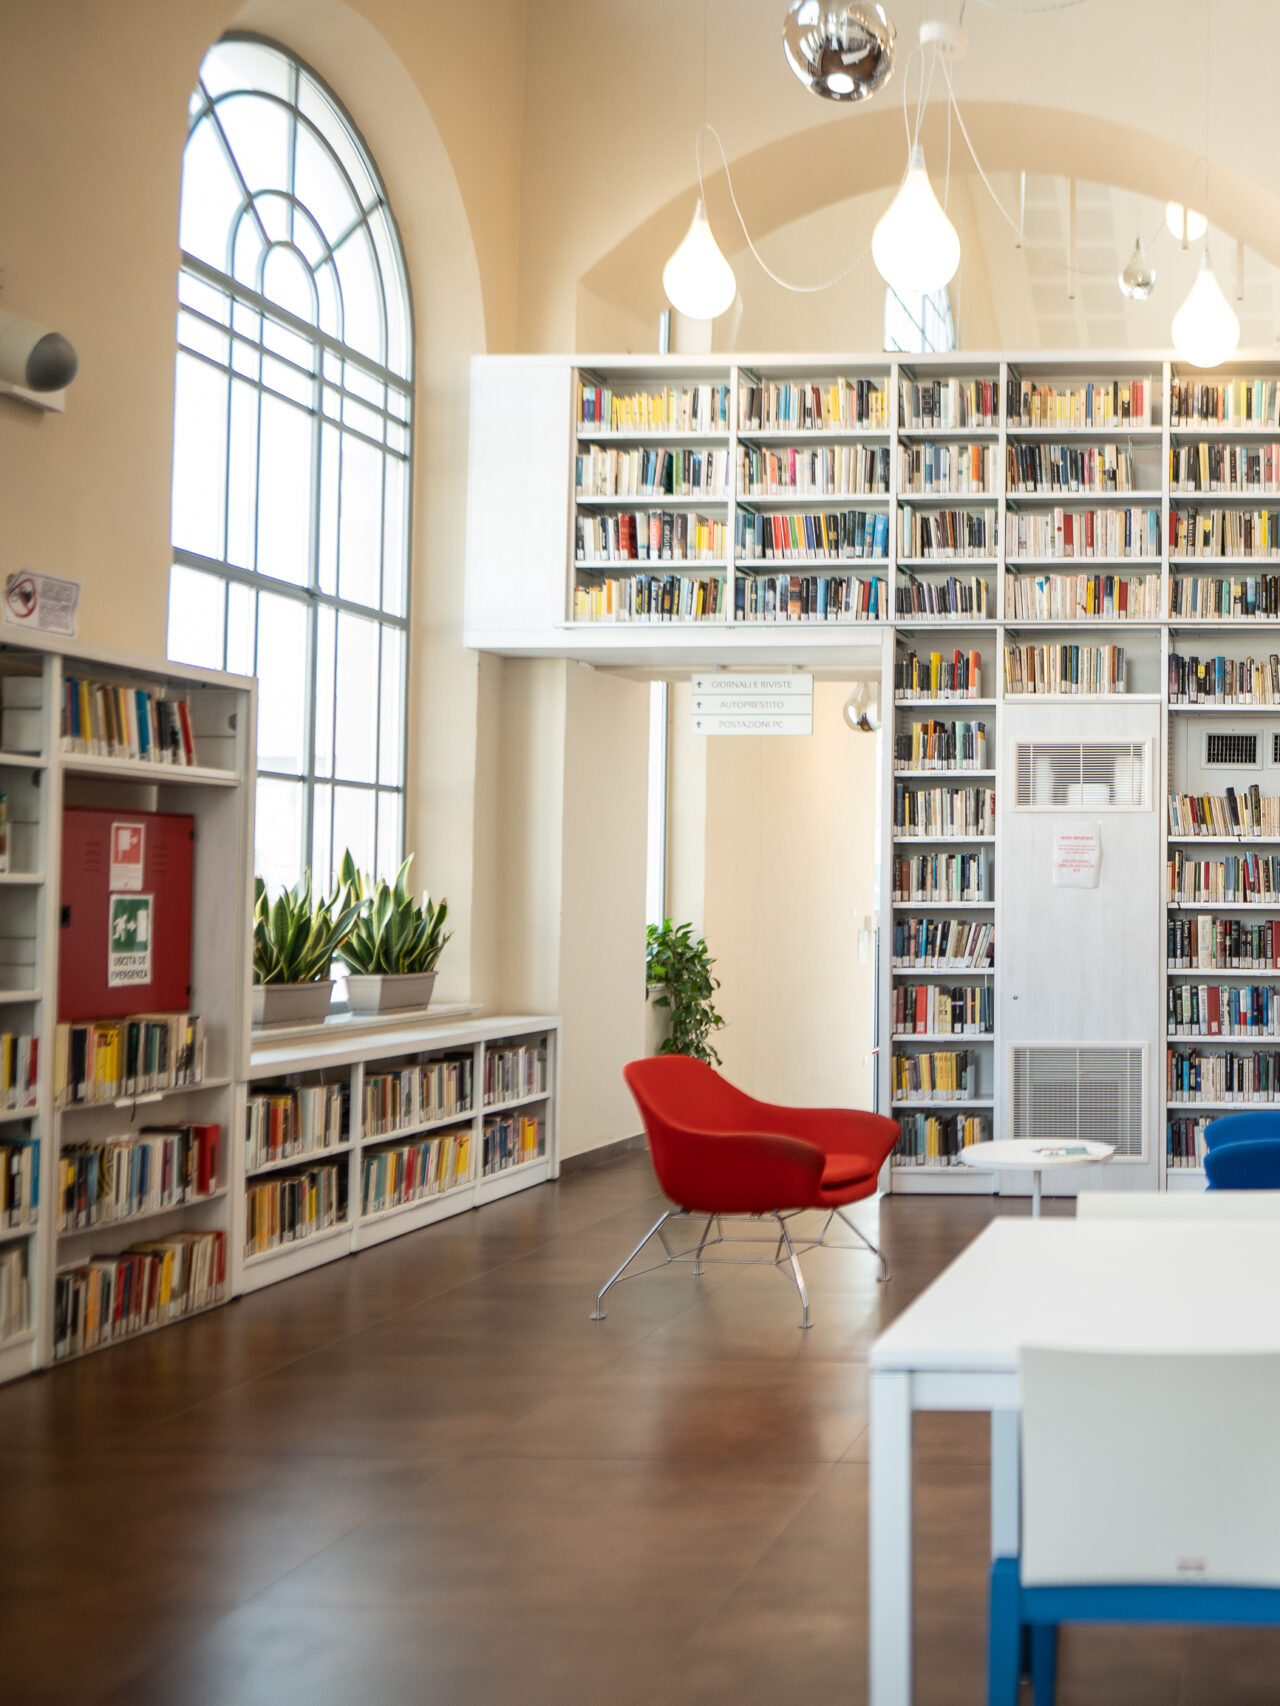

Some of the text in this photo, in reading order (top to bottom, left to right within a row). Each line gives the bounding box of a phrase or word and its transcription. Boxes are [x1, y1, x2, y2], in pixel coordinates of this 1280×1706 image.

[712, 681, 751, 689] GIORNALI
[761, 681, 792, 689] RIVISTE
[720, 701, 784, 709] AUTOPRESTITO
[719, 720, 771, 728] POSTAZIONI
[113, 956, 136, 967] USCITA
[111, 969, 148, 980] EMERGENZA
